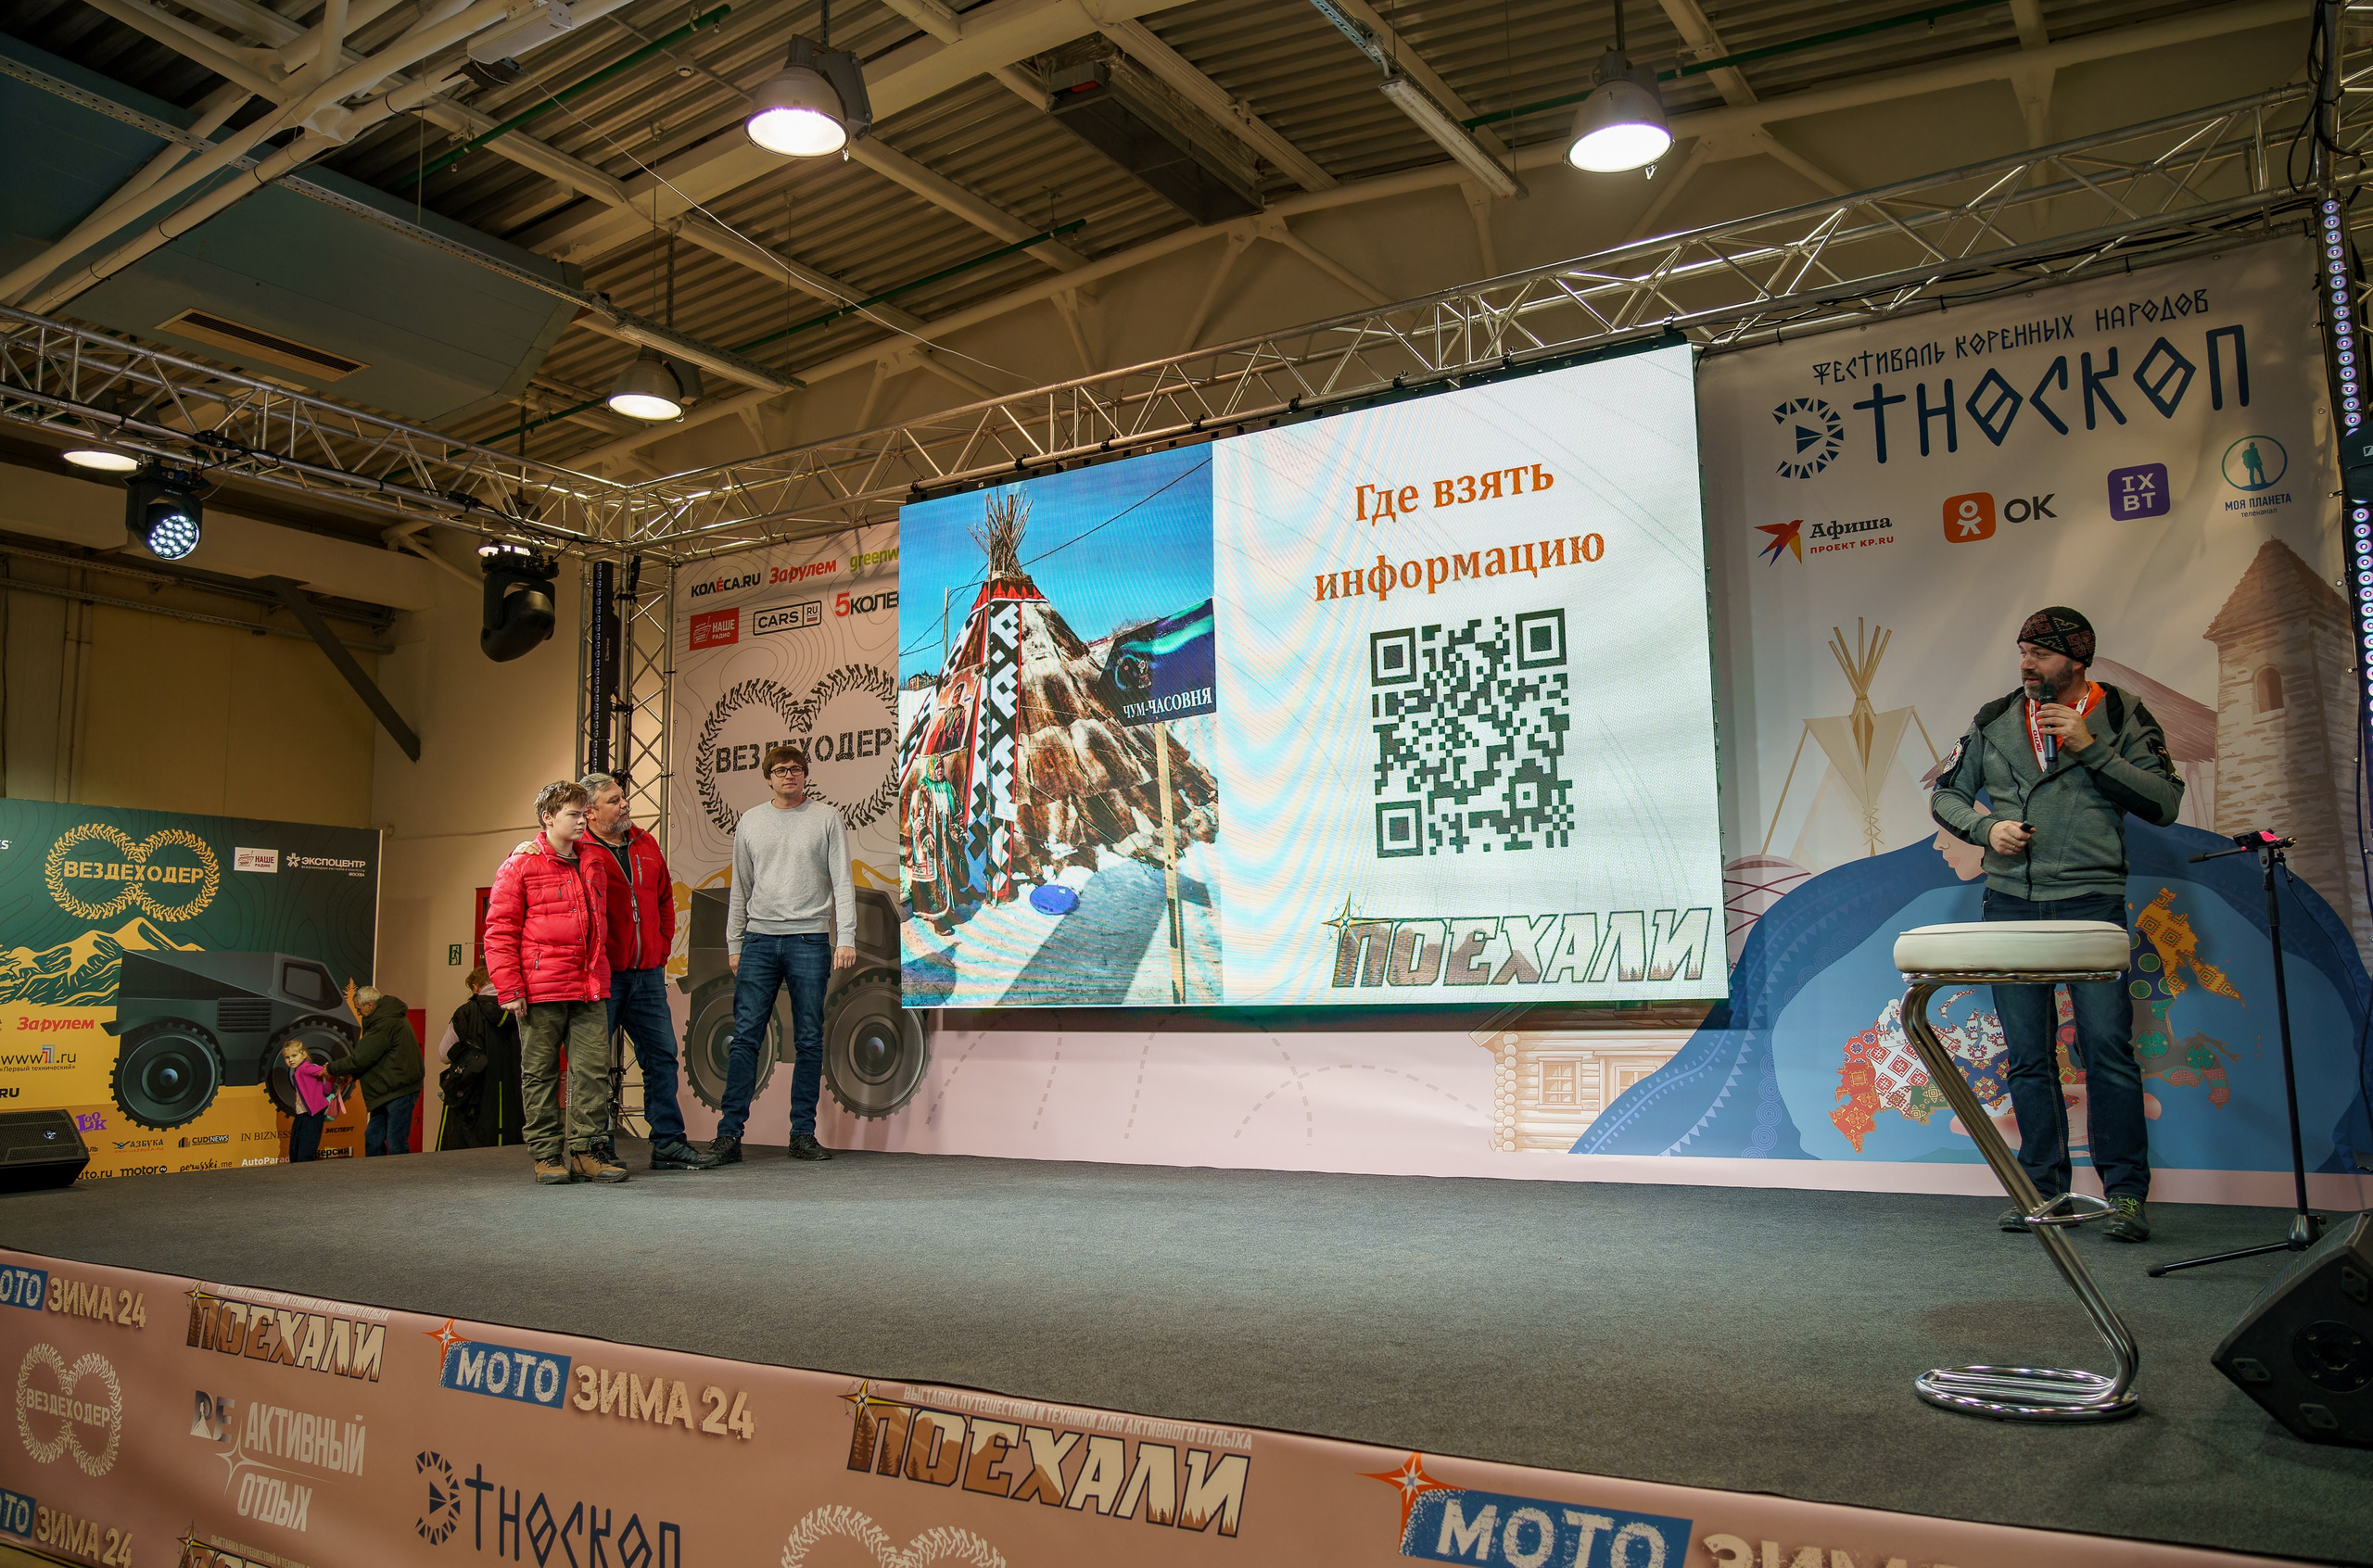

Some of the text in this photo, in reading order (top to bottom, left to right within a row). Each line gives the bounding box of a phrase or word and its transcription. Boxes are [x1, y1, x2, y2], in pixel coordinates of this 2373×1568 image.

[1812, 288, 2208, 386] ФЕСТИВАЛЬ КОРЕННЫХ НАРОДОВ
[1354, 462, 1555, 526] Где взять
[2121, 473, 2155, 493] IX
[2004, 493, 2058, 524] OK
[2124, 492, 2156, 512] BT
[2225, 493, 2292, 512] МОЯ ПЛАНЕТА
[2240, 508, 2278, 518] телеканал
[1808, 516, 1893, 540] Афиша
[1809, 540, 1856, 554] ПРОЕКТ
[1314, 529, 1605, 602] информацию
[758, 605, 818, 629] CARS RU
[835, 590, 899, 617] 5КОЛЕ
[712, 618, 735, 632] НАШЕ
[712, 631, 730, 640] РАДИО
[1123, 687, 1212, 719] ЧУМ-ЧАСОВНЯ
[64, 861, 205, 884] ВЕЗДЕХОДЕР
[255, 855, 275, 864] НАШЕ
[301, 856, 366, 868] ЭКСПОЦЕНТР
[1331, 906, 1714, 989] ПОЕХАЛИ
[241, 1133, 251, 1142] IN
[324, 1126, 354, 1134] ЭКСПЕРТ
[48, 1277, 114, 1322] ЗИМА
[118, 1289, 146, 1328] 24
[186, 1297, 387, 1383] ПОЕХАЛИ
[27, 1387, 110, 1428] ВЕЗДЕХОДЕР
[455, 1346, 755, 1440] МОТО ЗИМА 24
[903, 1385, 958, 1410] ВЫСТАВКА
[959, 1395, 1036, 1421] ПУТЕШЕСТВИЙ
[1046, 1406, 1098, 1429] ТЕХНИКИ
[1097, 1415, 1123, 1434] ДЛЯ
[1123, 1418, 1196, 1444] АКТИВНОГО
[1196, 1428, 1253, 1451] ОТДЫХА
[244, 1401, 366, 1477] АКТИВНЫЙ
[847, 1405, 1251, 1538] ПОЕХАЛИ
[237, 1473, 313, 1533] ОТДЫХ
[0, 1491, 29, 1534] ТО
[37, 1506, 99, 1562] ЗИМА
[102, 1527, 133, 1568] 24
[1436, 1498, 1669, 1568] МОТО
